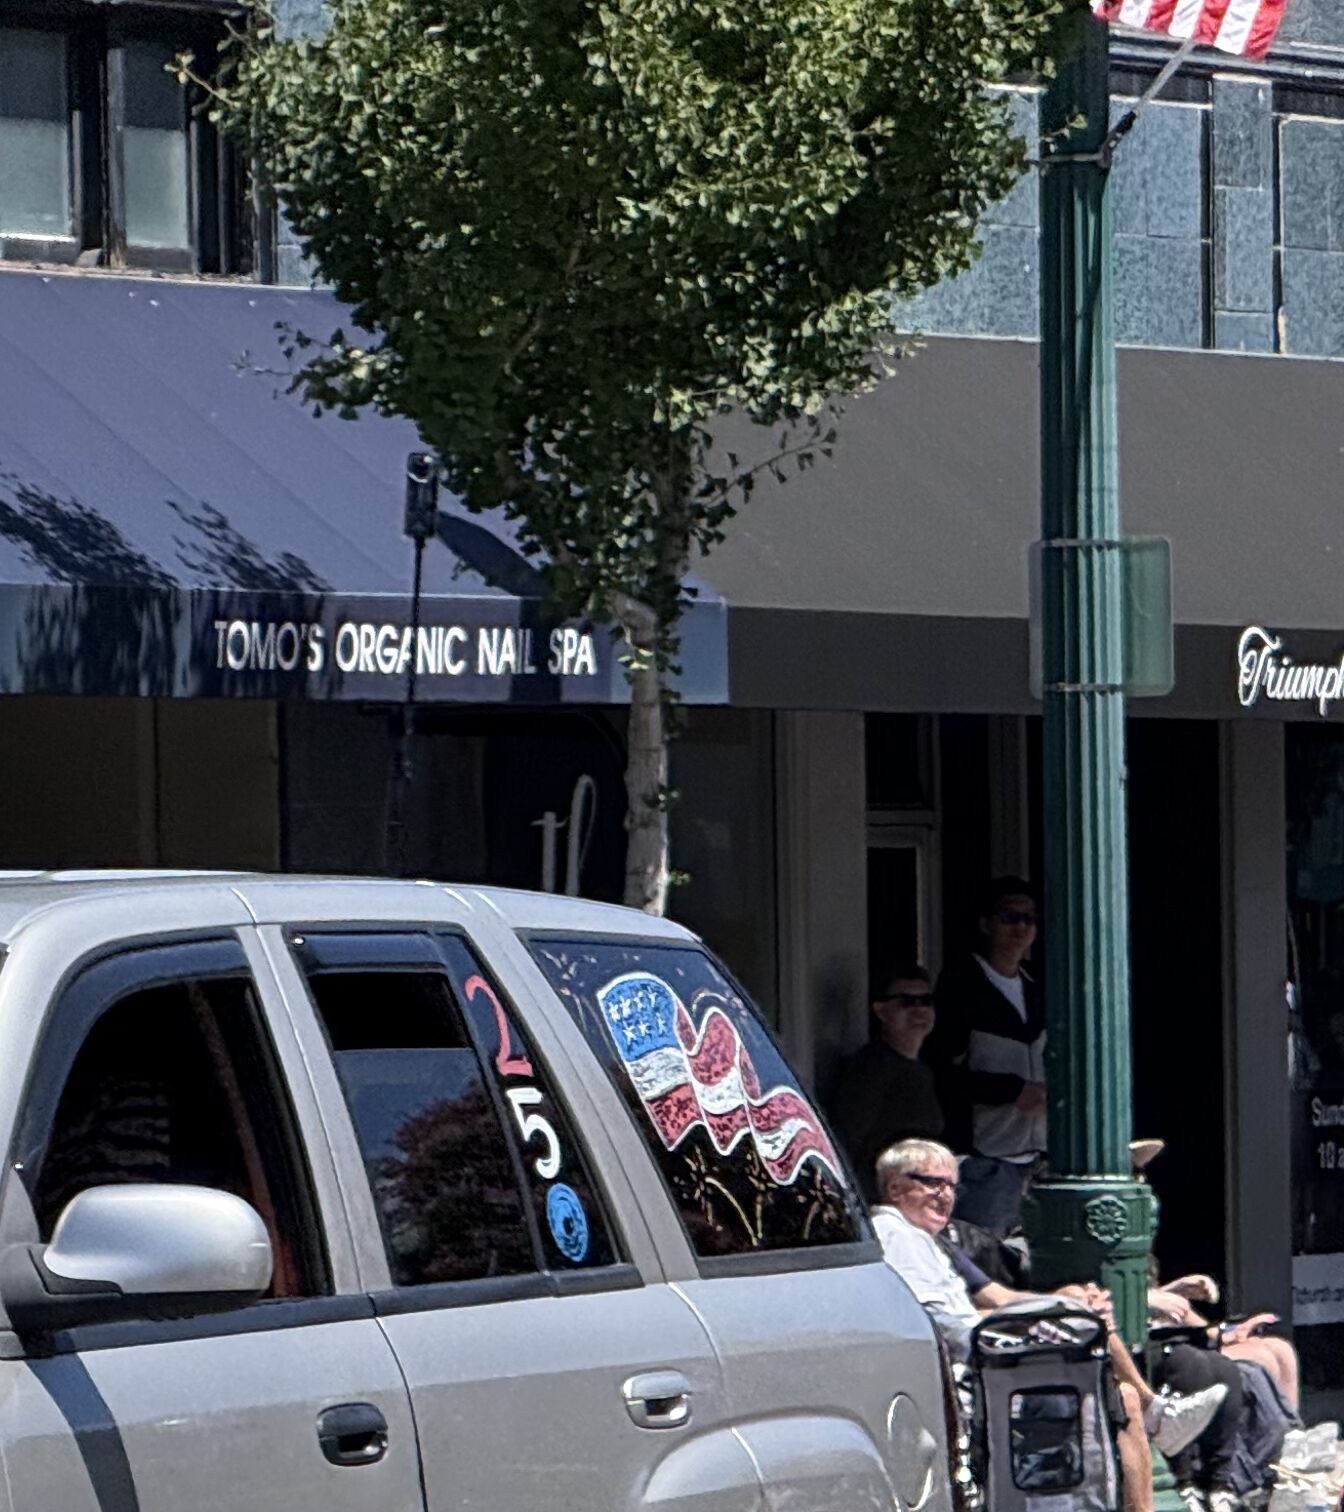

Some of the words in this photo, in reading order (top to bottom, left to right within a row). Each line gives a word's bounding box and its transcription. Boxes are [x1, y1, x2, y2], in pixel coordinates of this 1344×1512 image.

[214, 619, 326, 672] TOMO'S
[335, 622, 468, 676] ORGANIC
[477, 627, 537, 676] NAIL
[548, 627, 597, 676] SPA
[1237, 626, 1344, 716] Triump
